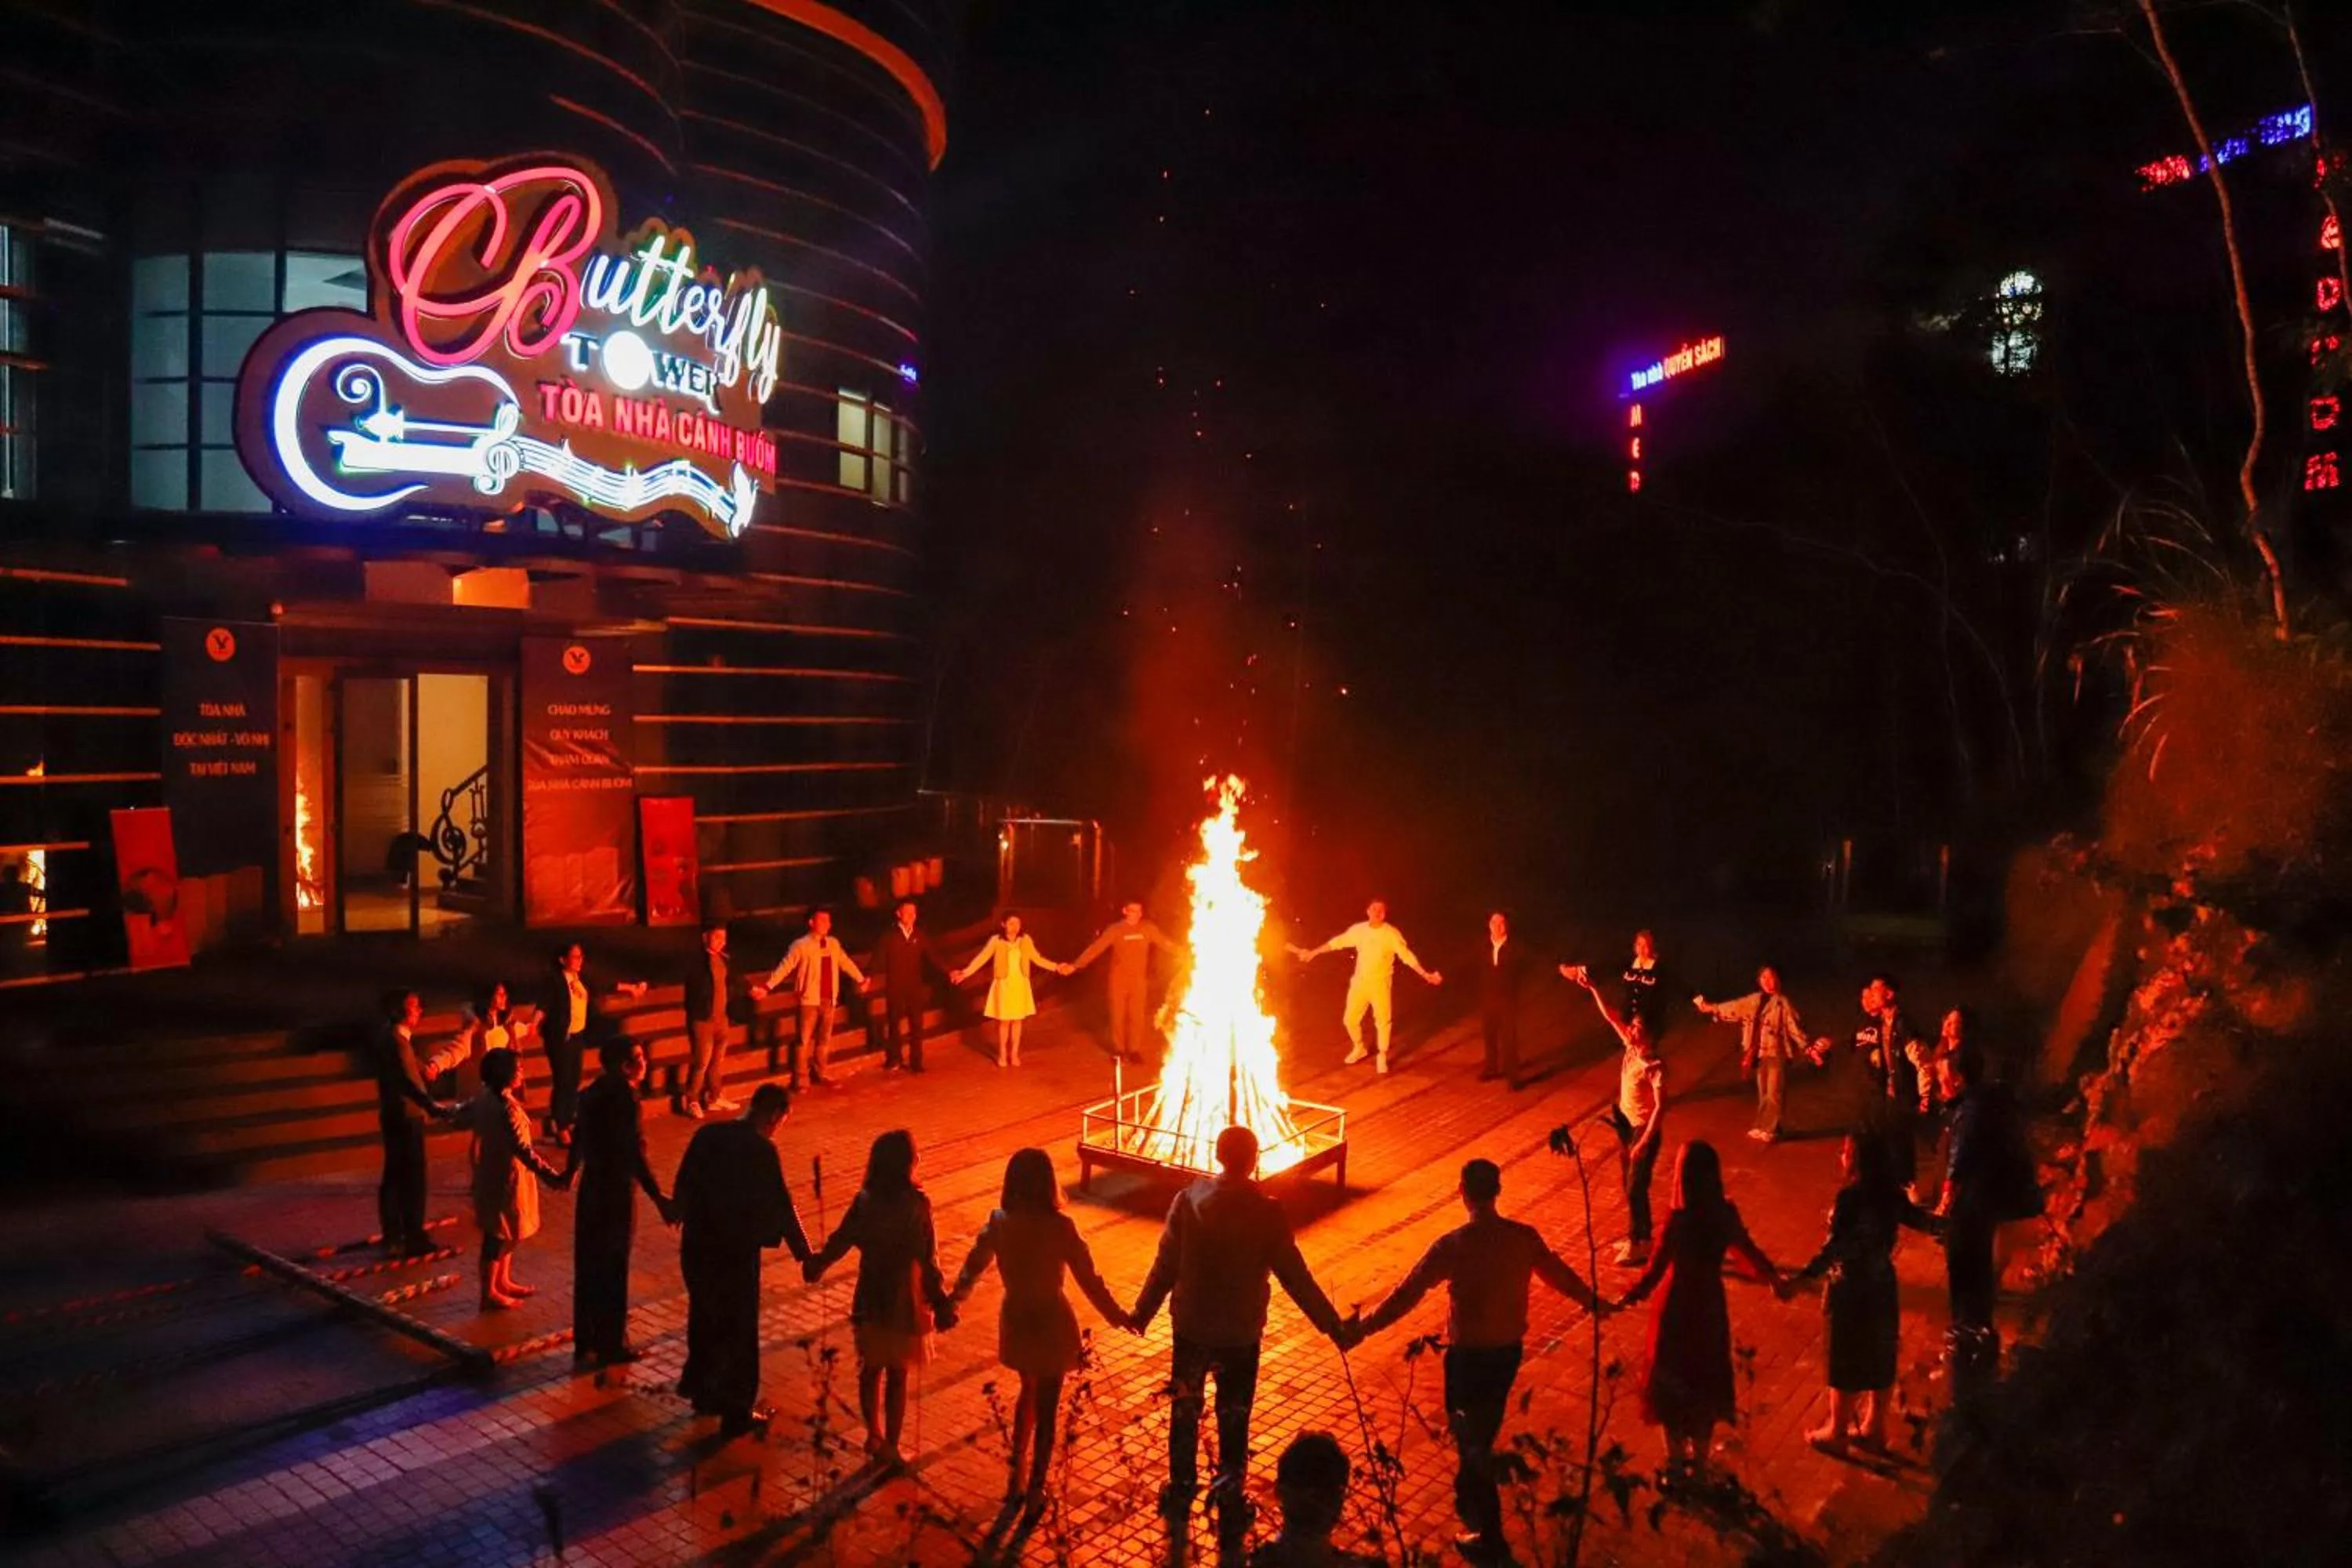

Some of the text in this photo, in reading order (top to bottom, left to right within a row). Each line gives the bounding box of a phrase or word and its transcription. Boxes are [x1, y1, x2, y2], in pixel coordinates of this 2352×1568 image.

[390, 167, 781, 404] Butterfly
[1694, 336, 1721, 366] SÁCH
[538, 376, 604, 428] TÒA
[614, 397, 672, 443] NHÀ
[677, 411, 733, 459] CÁNH
